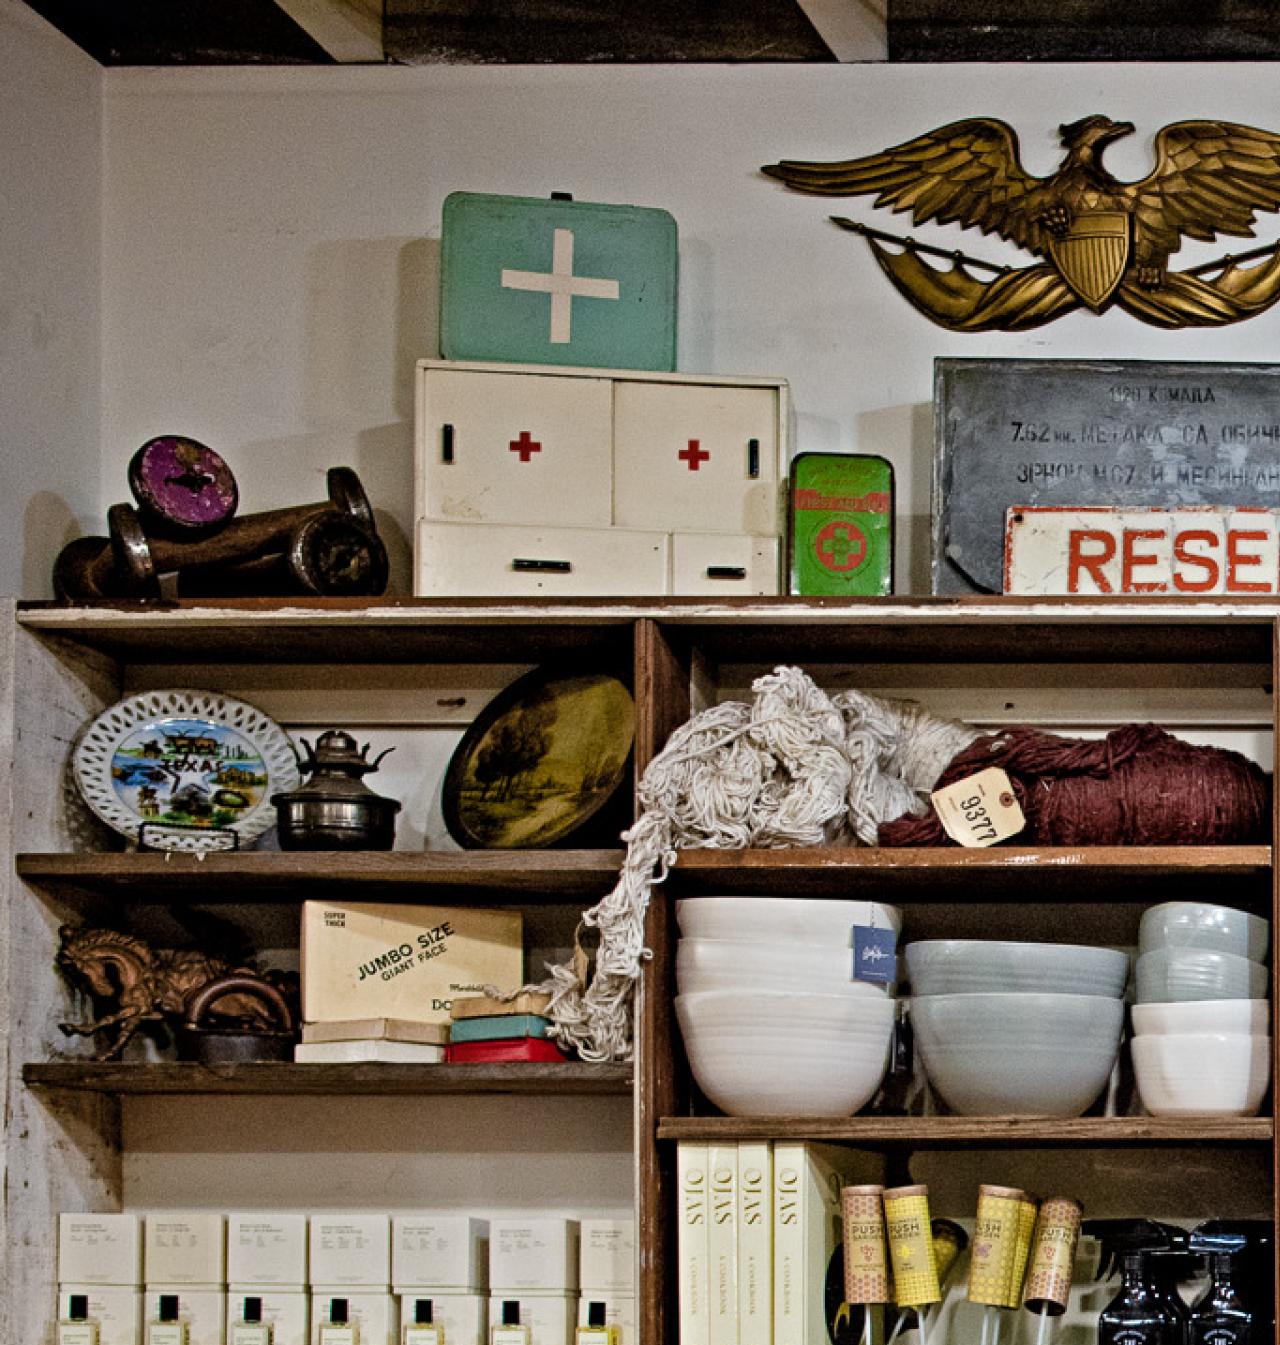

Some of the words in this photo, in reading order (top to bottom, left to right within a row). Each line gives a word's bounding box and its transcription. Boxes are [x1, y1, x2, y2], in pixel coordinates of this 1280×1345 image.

[960, 795, 999, 841] 9377
[358, 943, 414, 981] JUMBO
[417, 921, 455, 949] SIZE
[381, 959, 415, 982] GIANT
[418, 942, 448, 964] FACE
